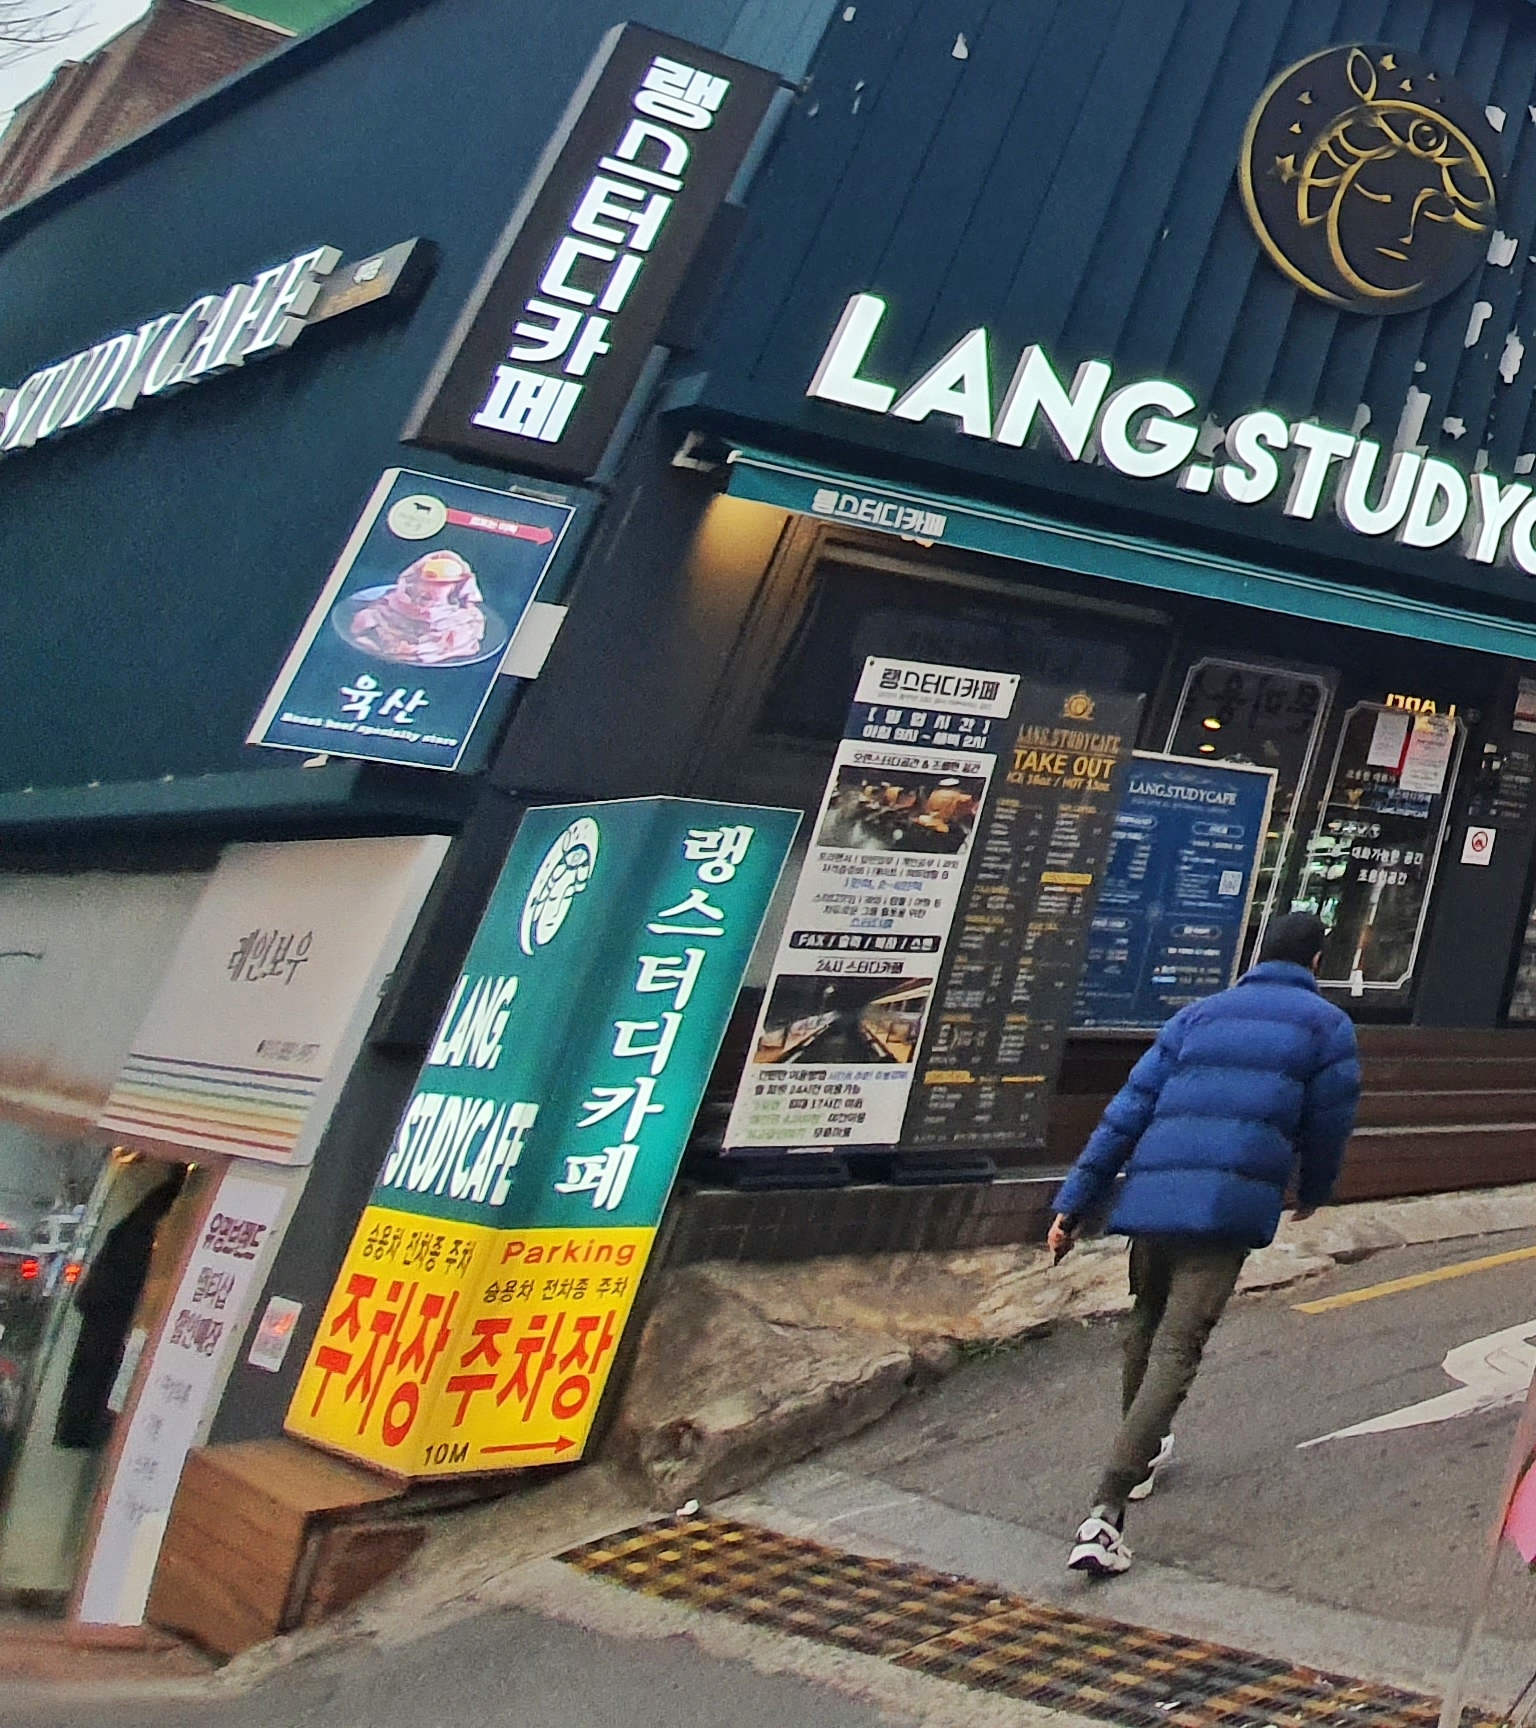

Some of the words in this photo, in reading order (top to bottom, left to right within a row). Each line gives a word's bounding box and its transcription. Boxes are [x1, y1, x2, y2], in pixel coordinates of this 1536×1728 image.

[340, 673, 430, 724] 육산
[879, 668, 1000, 701] 랭스터디카페
[1013, 749, 1068, 774] TAKE
[1074, 756, 1117, 779] OUT
[798, 933, 826, 947] FAX
[429, 974, 519, 1072] LANG
[555, 825, 755, 1211] 랭스터디카페
[382, 1090, 539, 1207] STUDYCAFE
[445, 1239, 477, 1279] 주차
[500, 1239, 636, 1268] Parking
[482, 1279, 535, 1304] 승용차
[541, 1278, 590, 1301] 전차종
[595, 1277, 628, 1299] 주차
[311, 1273, 460, 1448] 주차장
[445, 1310, 617, 1428] 주차장
[424, 1442, 470, 1466] 10M
